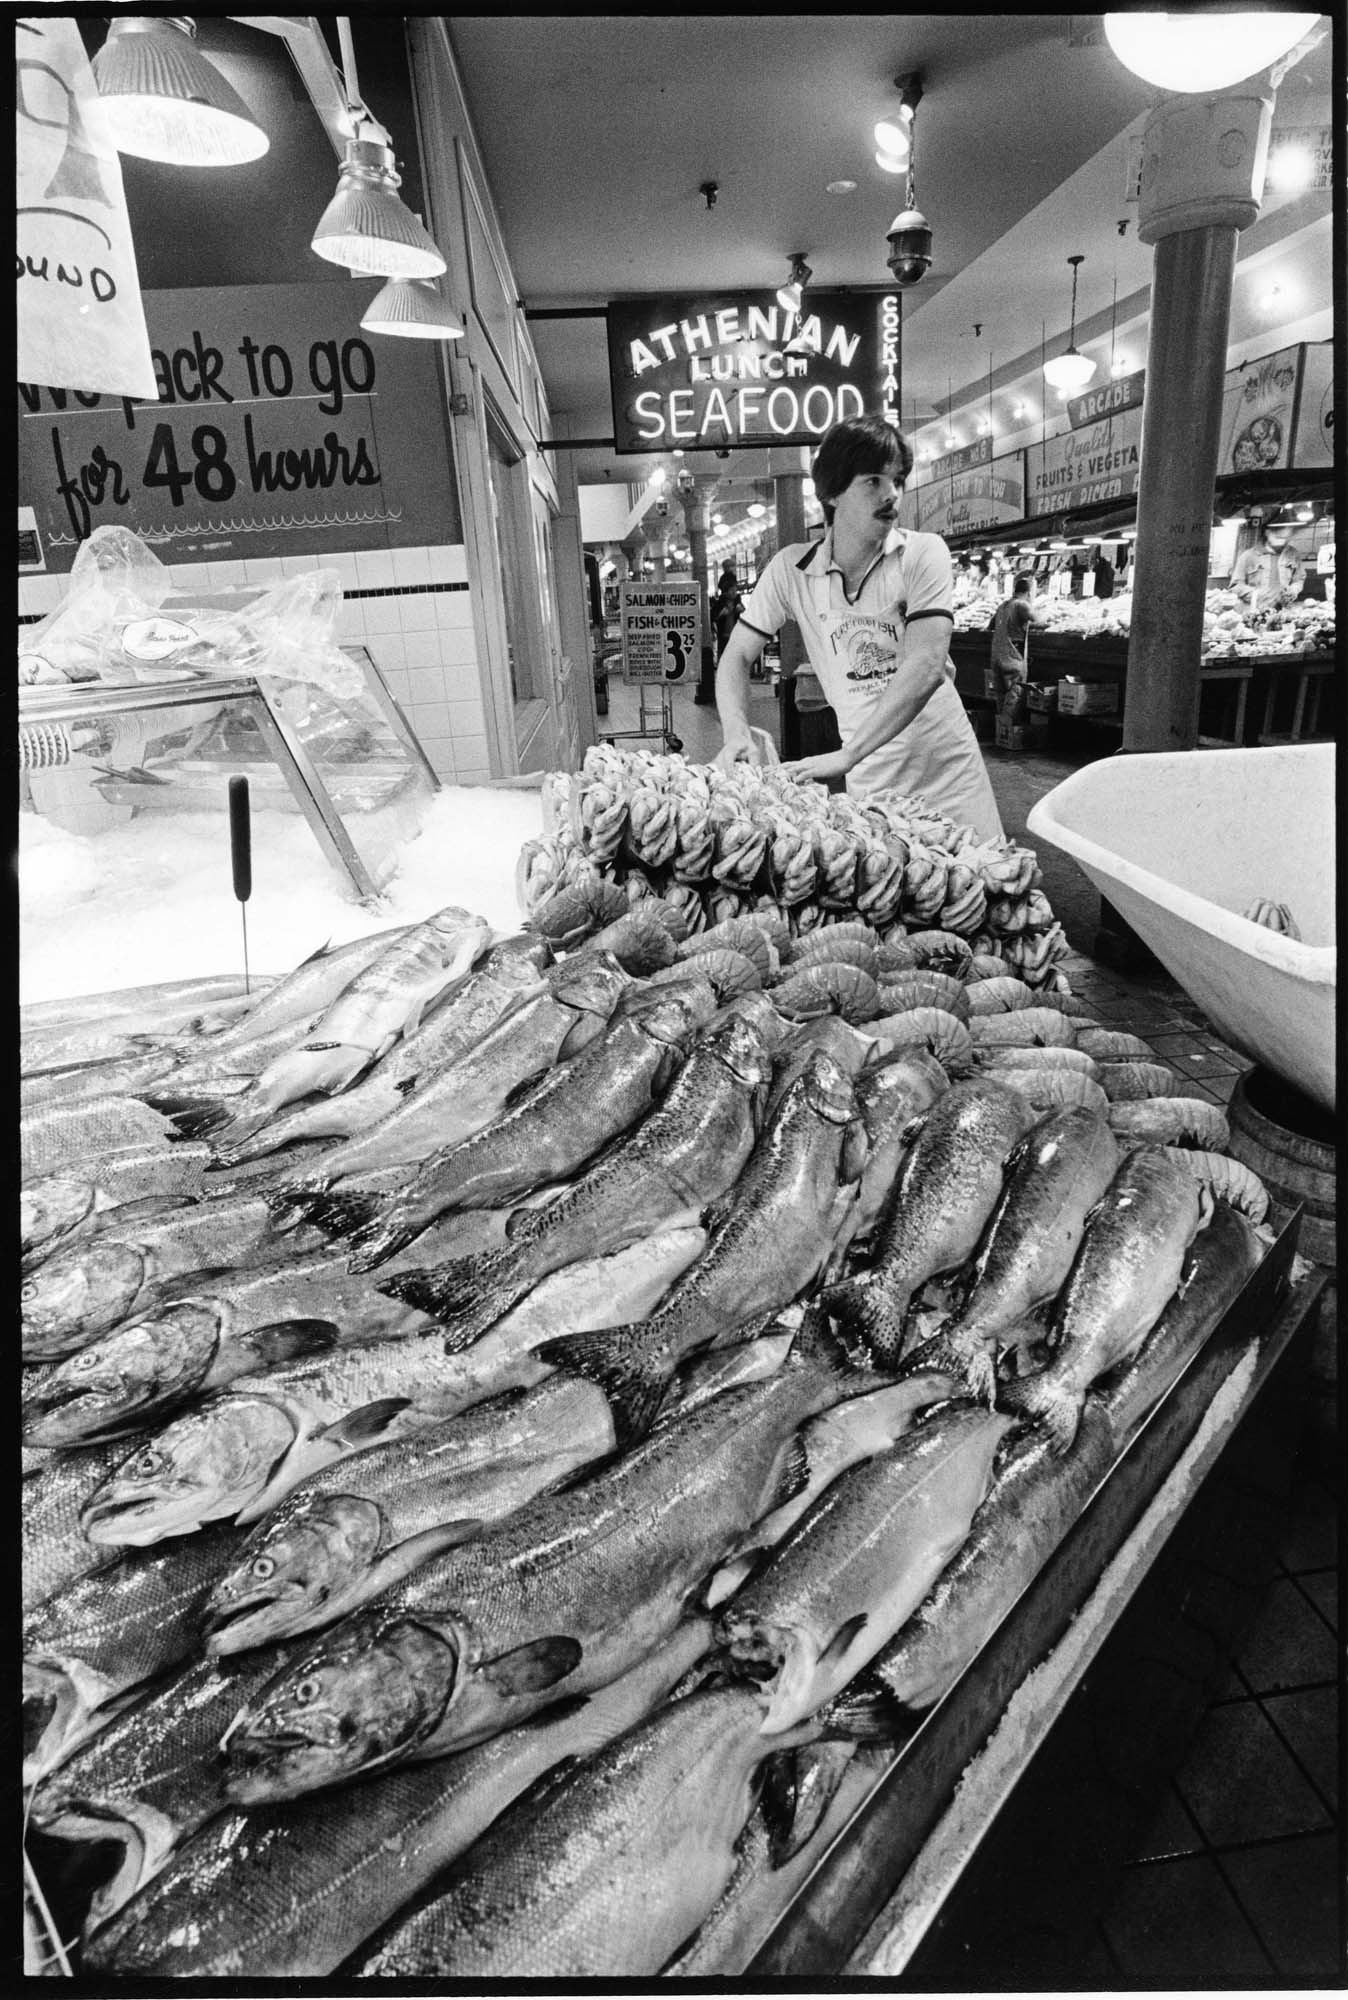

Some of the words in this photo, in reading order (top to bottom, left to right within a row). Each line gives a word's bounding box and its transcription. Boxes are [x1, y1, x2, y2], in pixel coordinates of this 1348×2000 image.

[629, 306, 861, 376] ATHENIAN
[882, 296, 899, 428] COCKTAILS
[238, 335, 293, 396] to
[309, 337, 376, 416] go
[690, 353, 808, 381] LUNCH
[635, 385, 864, 438] SEAFOOD
[1080, 382, 1130, 420] ARCADE
[50, 427, 129, 541] for
[143, 423, 236, 507] 48
[245, 414, 382, 492] hours
[1036, 464, 1073, 490] FRUITS
[1037, 491, 1072, 515] FRESH
[1080, 478, 1121, 505] PICKED
[625, 593, 665, 606] SALMON
[669, 593, 697, 606] CHIPS
[627, 616, 654, 629] FISH
[661, 615, 696, 629] CHIPS
[665, 630, 686, 680] 3
[683, 633, 695, 646] 25
